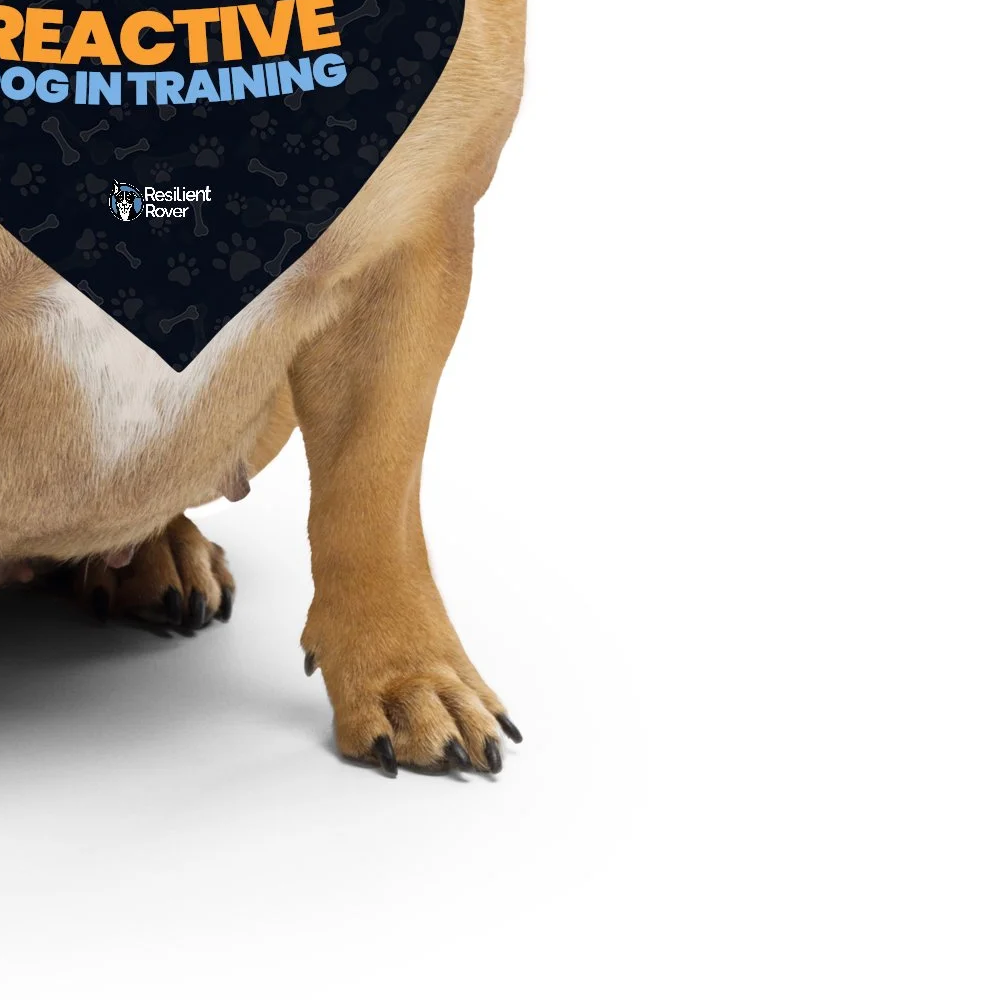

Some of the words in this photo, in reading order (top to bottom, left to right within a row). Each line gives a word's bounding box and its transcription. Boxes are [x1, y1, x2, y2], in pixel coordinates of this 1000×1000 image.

[75, 71, 121, 105] IN
[127, 54, 347, 105] TRAINING
[144, 185, 212, 202] Resilient
[145, 203, 189, 218] Rover
